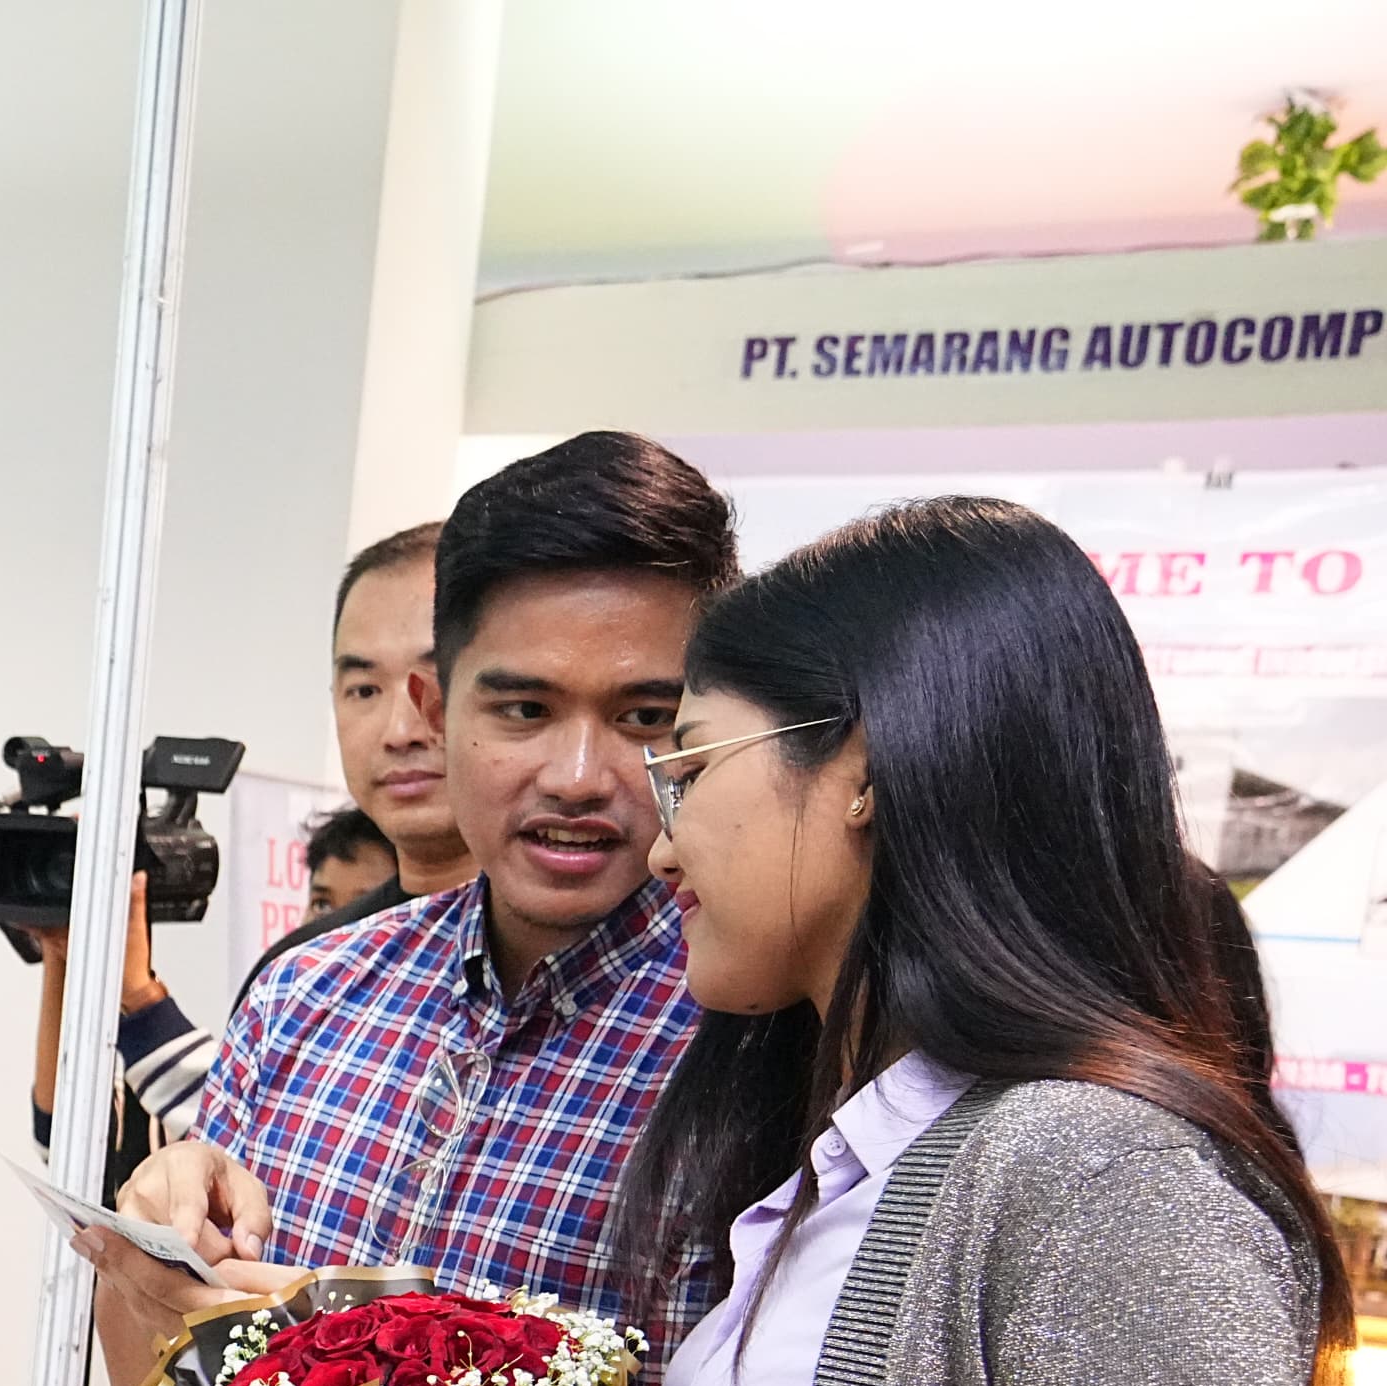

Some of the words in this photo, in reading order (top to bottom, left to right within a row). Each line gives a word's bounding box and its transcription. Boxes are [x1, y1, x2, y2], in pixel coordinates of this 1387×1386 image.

[740, 336, 797, 379] PT.
[811, 327, 1070, 377] SEMARANG
[1080, 309, 1384, 370] AUTOCOMP
[1238, 549, 1363, 596] TO
